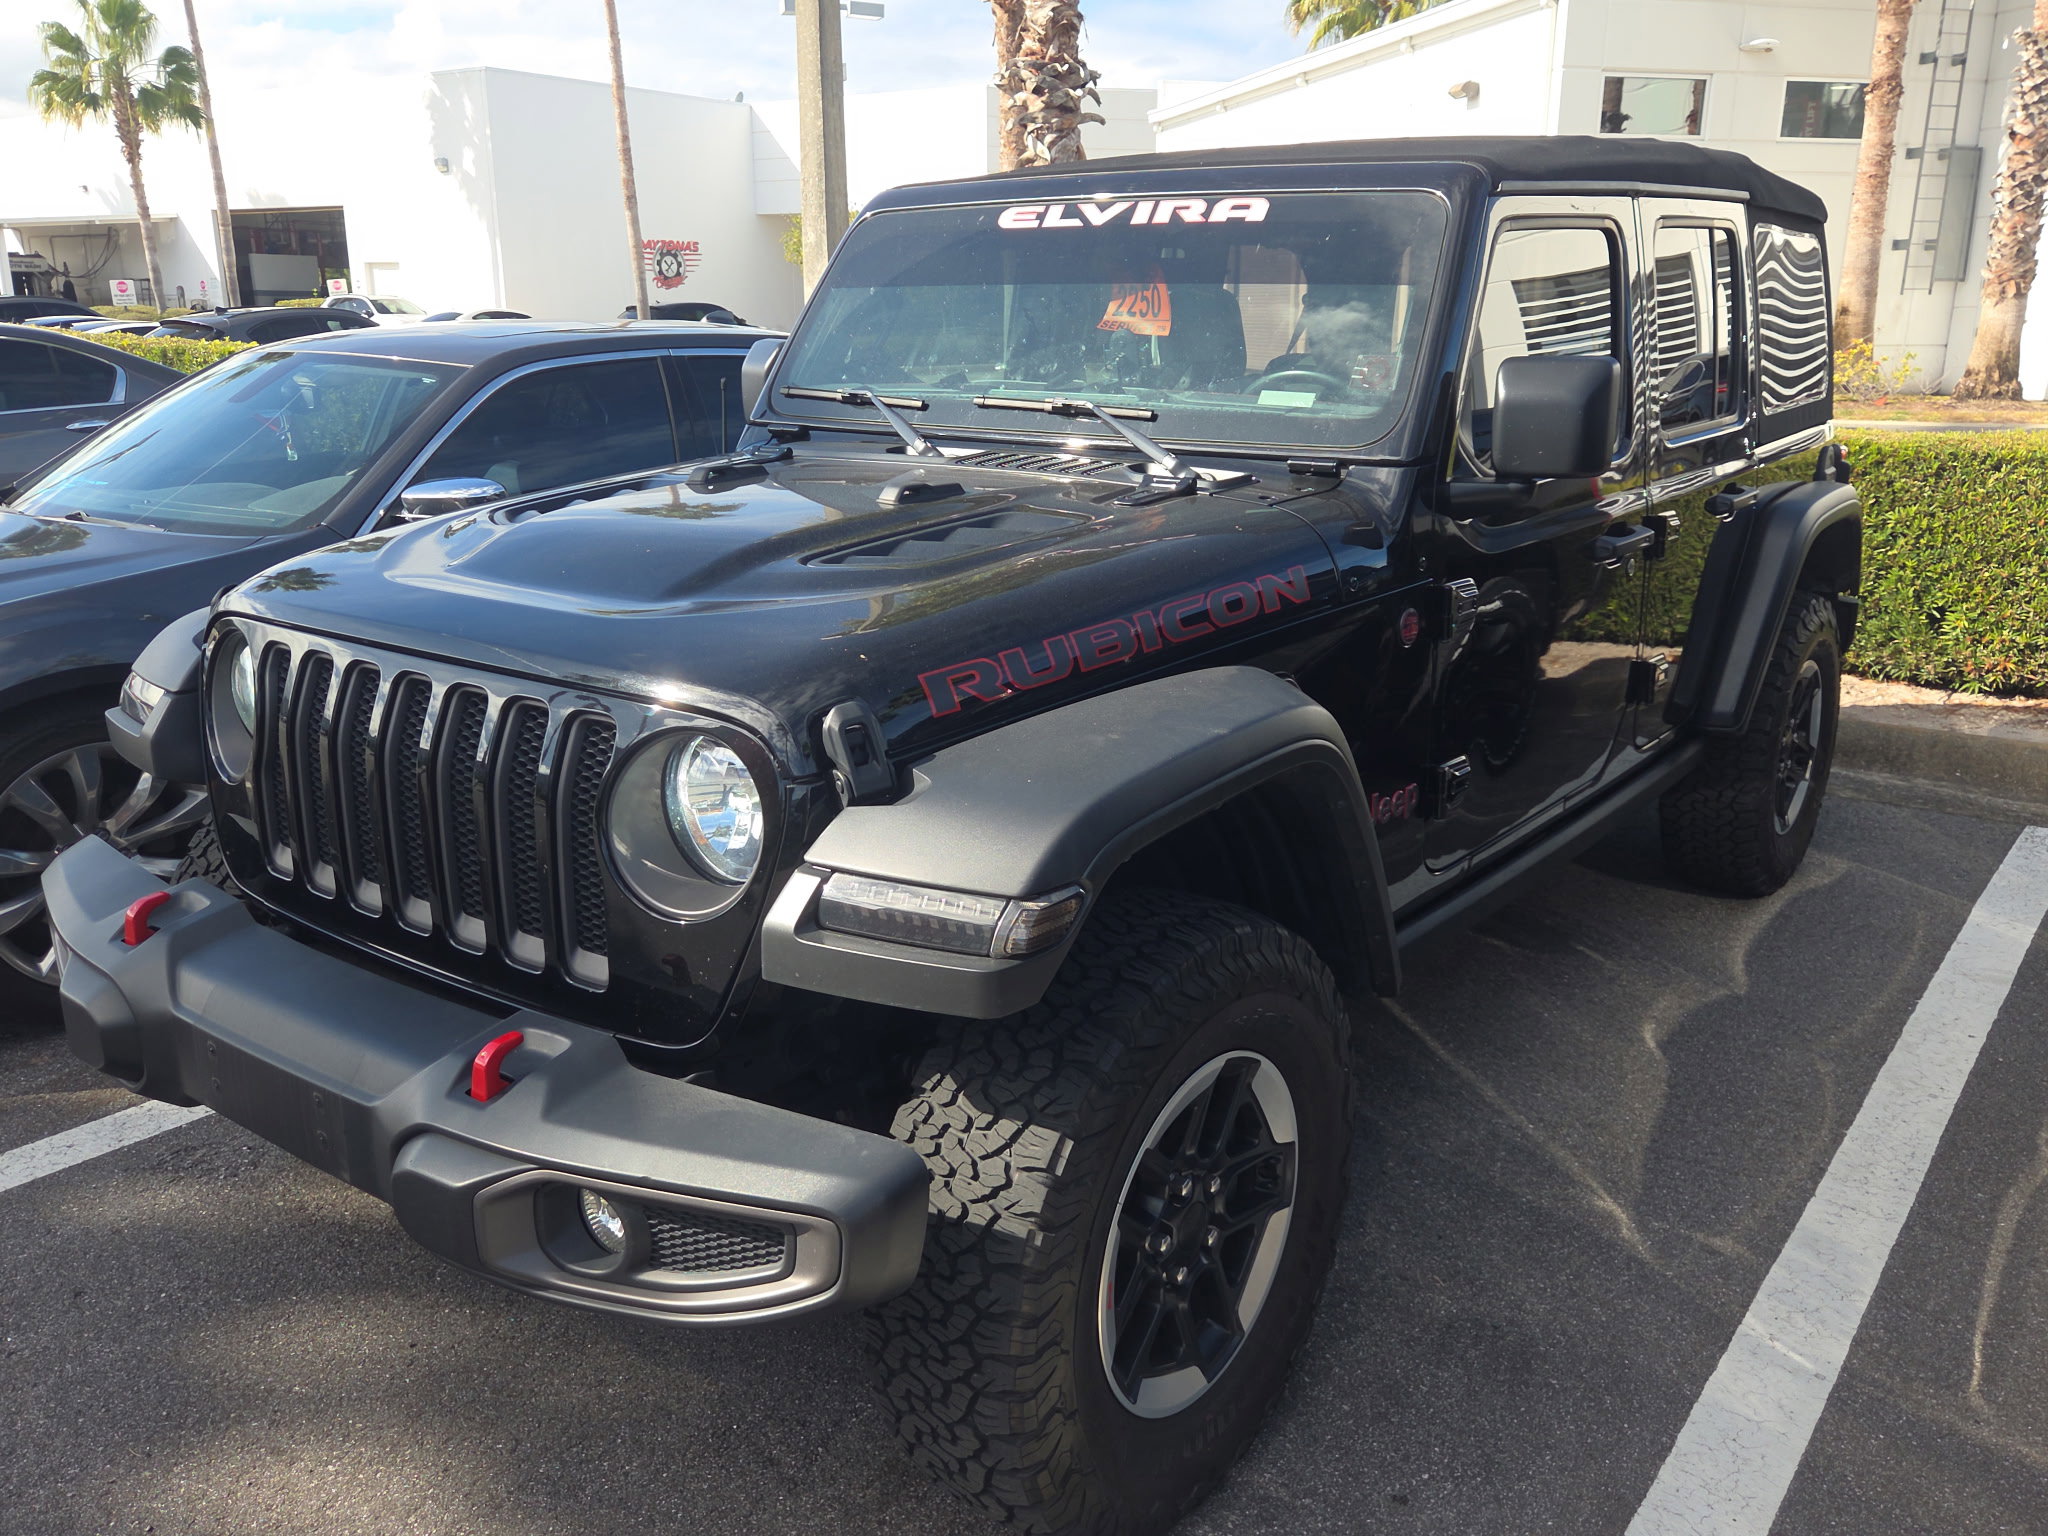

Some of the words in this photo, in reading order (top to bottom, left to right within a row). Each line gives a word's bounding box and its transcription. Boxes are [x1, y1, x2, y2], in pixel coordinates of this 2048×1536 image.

[998, 197, 1270, 230] ELVIRA
[1111, 284, 1162, 318] 2250
[917, 565, 1312, 718] RUBICON
